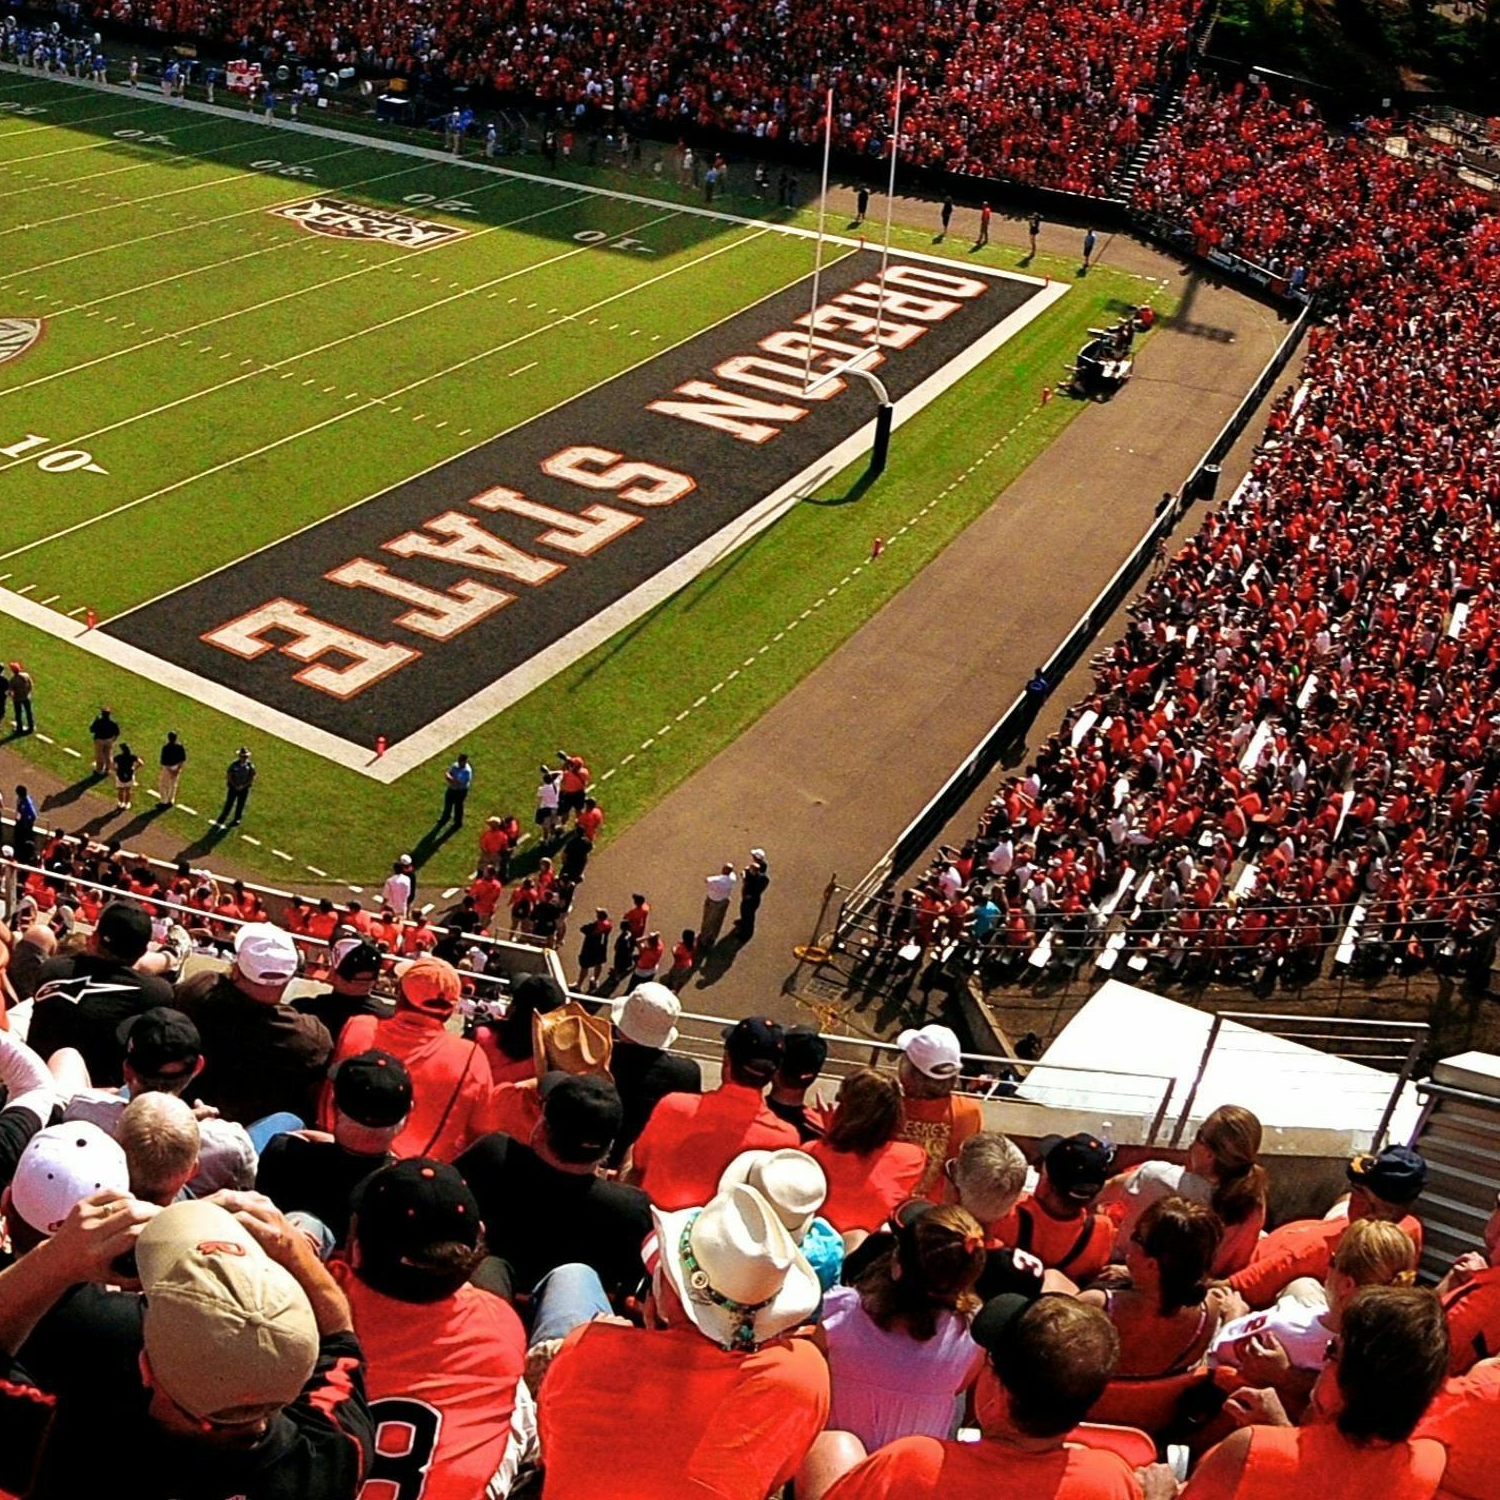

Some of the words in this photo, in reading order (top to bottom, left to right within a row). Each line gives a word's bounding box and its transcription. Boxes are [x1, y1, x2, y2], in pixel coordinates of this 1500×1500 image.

[283, 200, 449, 246] RESER
[403, 194, 472, 212] 20
[573, 230, 644, 250] 10
[645, 265, 990, 445] OREGON
[200, 443, 698, 700] STATE
